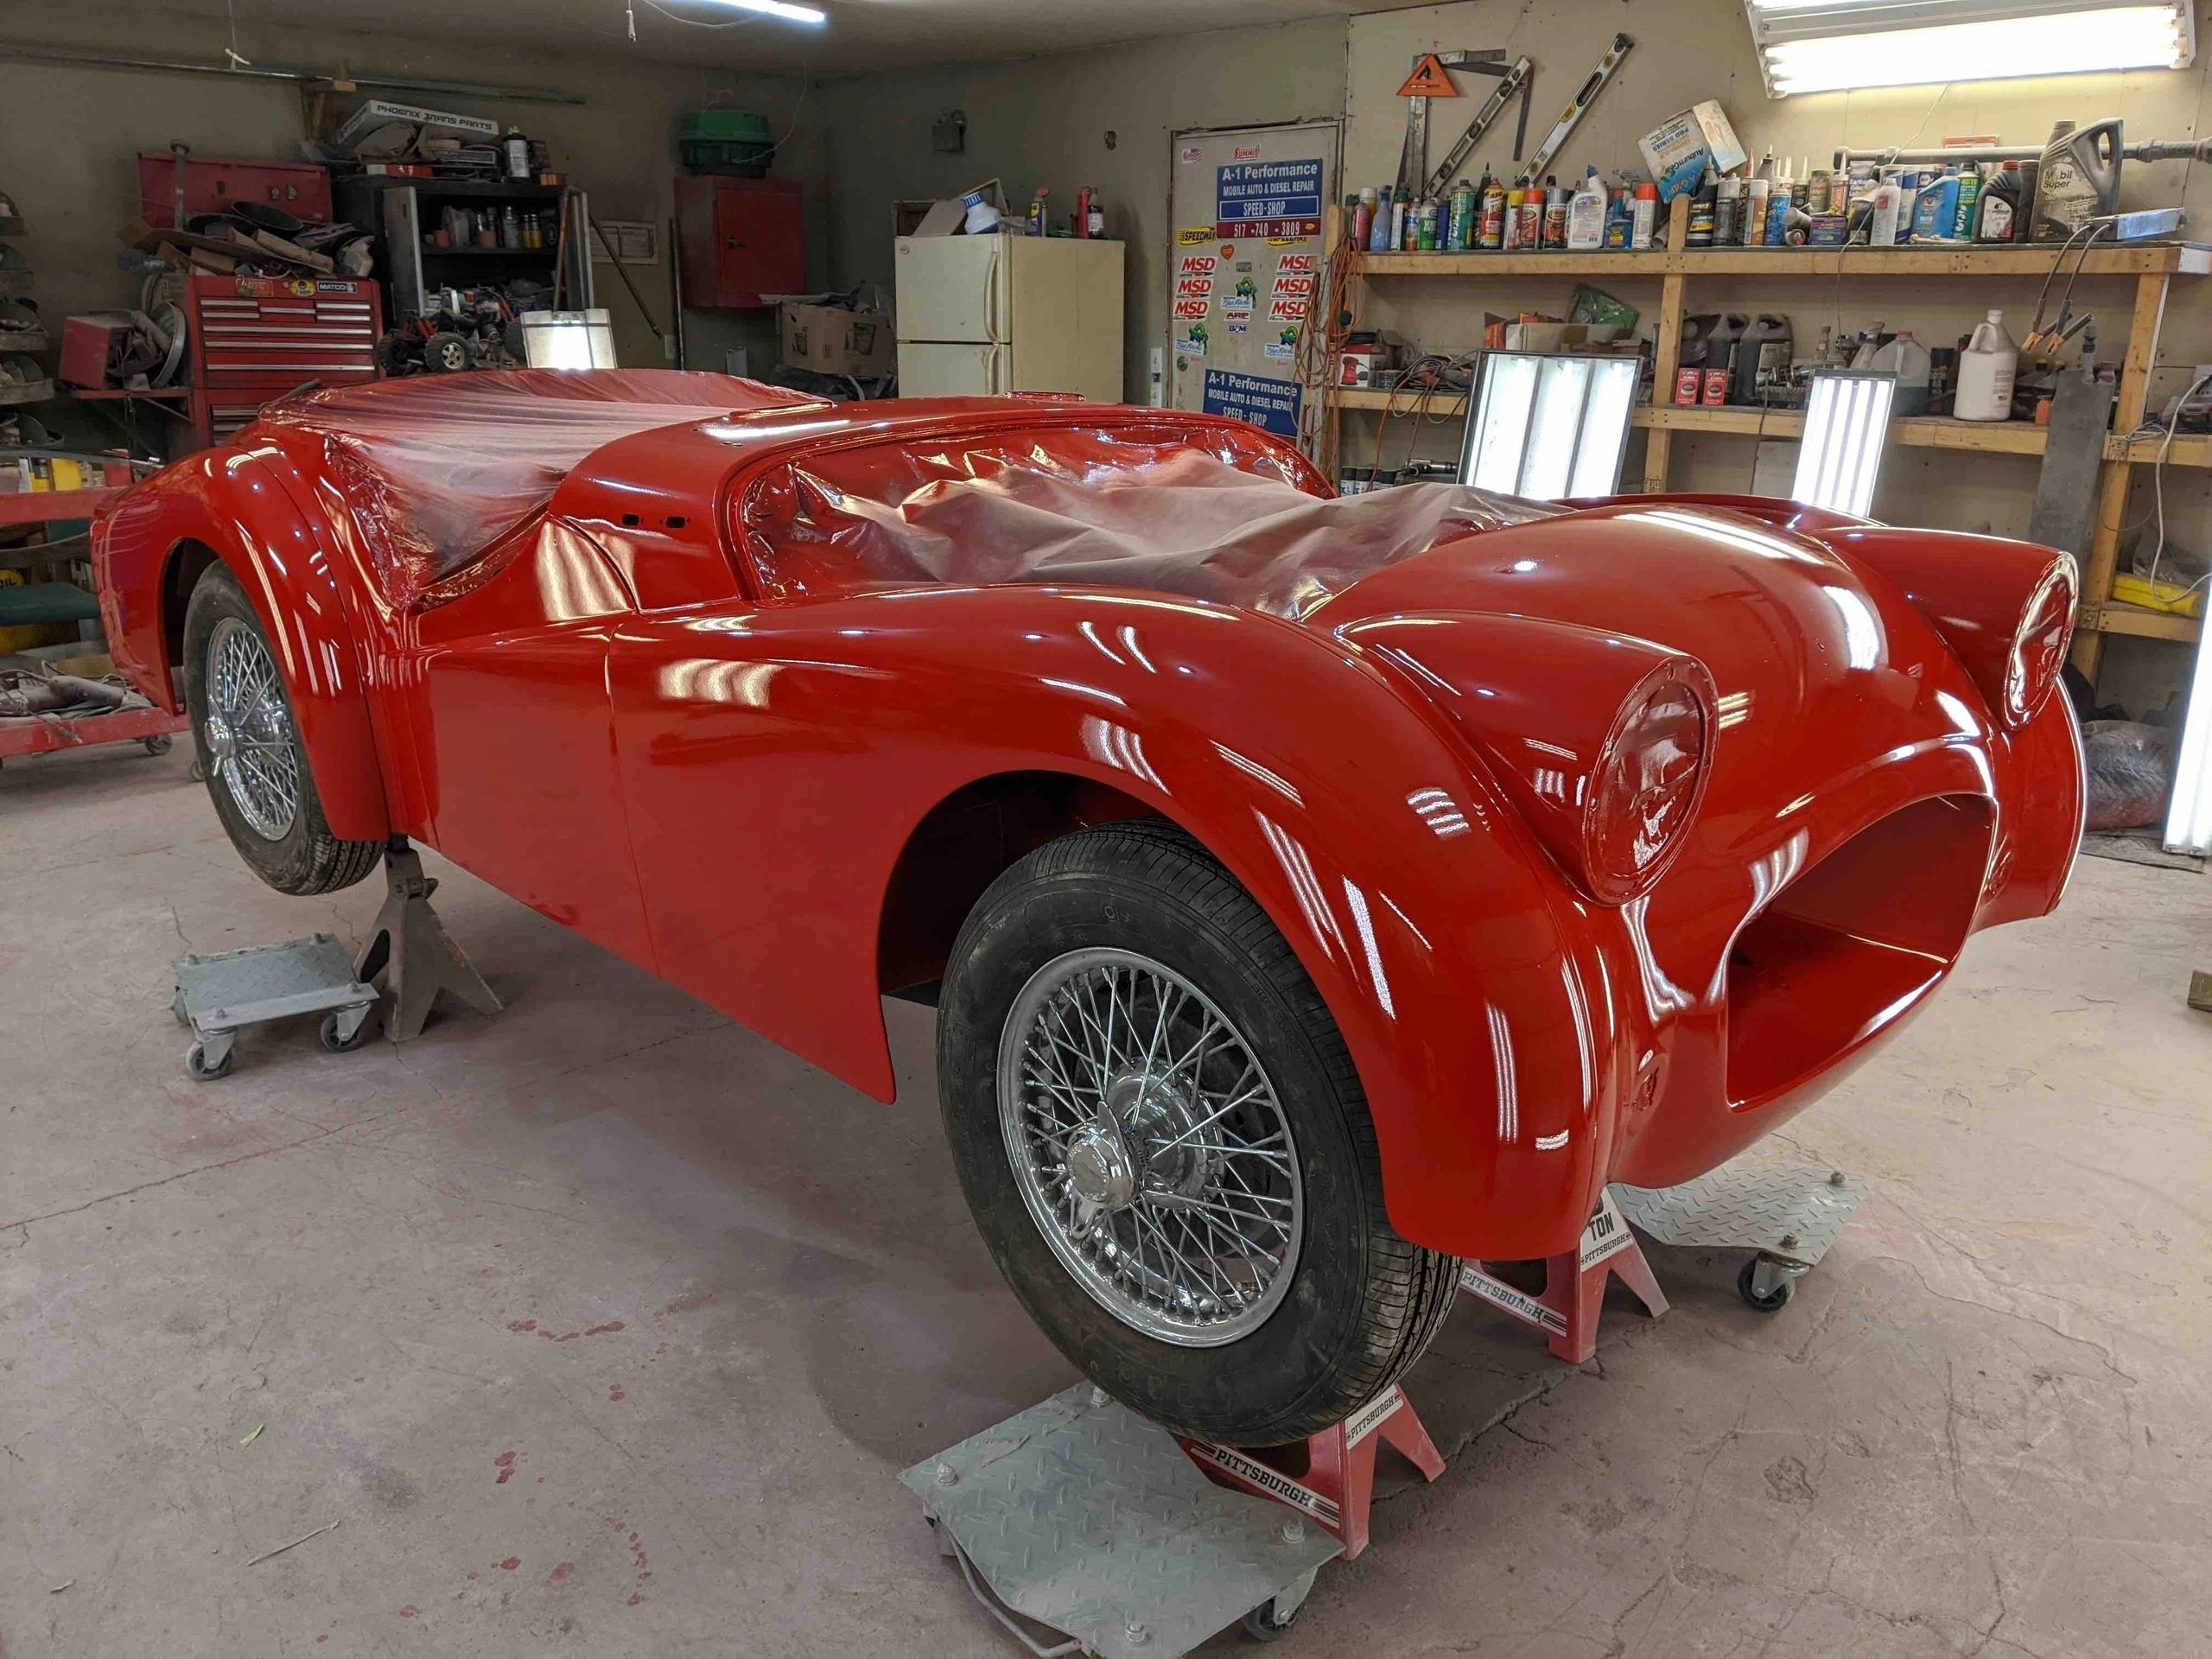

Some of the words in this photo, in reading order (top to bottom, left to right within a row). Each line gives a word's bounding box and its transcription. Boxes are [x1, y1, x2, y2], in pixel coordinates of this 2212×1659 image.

[378, 104, 420, 118] PHOENIX
[460, 118, 493, 130] PARTS
[1222, 167, 1241, 181] A-1
[1244, 163, 1318, 180] Performance
[2044, 170, 2073, 180] Mbil
[1223, 184, 1246, 197] MOBILE
[1247, 183, 1263, 195] AUTO
[1264, 184, 1269, 194] &
[1269, 181, 1291, 193] DIESEL
[1292, 180, 1314, 191] REPAIR
[2043, 180, 2070, 189] Super
[1234, 223, 1246, 238] 517
[1281, 221, 1300, 235] 3809
[1181, 258, 1217, 271] MSD
[1178, 279, 1213, 294] MSD
[1274, 278, 1312, 293] MSD
[1174, 302, 1210, 315] MSD
[1271, 301, 1308, 315] MSD
[1208, 372, 1225, 385] A-1
[1228, 374, 1298, 397] Performance
[1208, 389, 1229, 401] MOBILE
[1229, 392, 1245, 404] AUTO
[1251, 396, 1272, 409] DIESEL
[1249, 411, 1268, 428] SHOP
[1588, 1211, 1615, 1242] TON
[1584, 1233, 1626, 1263] PITTSBURGH
[1463, 1271, 1543, 1321] PITTSBURGH
[1351, 1395, 1395, 1440] PITTSBURGH
[1215, 1448, 1313, 1509] PITTSBURGH
